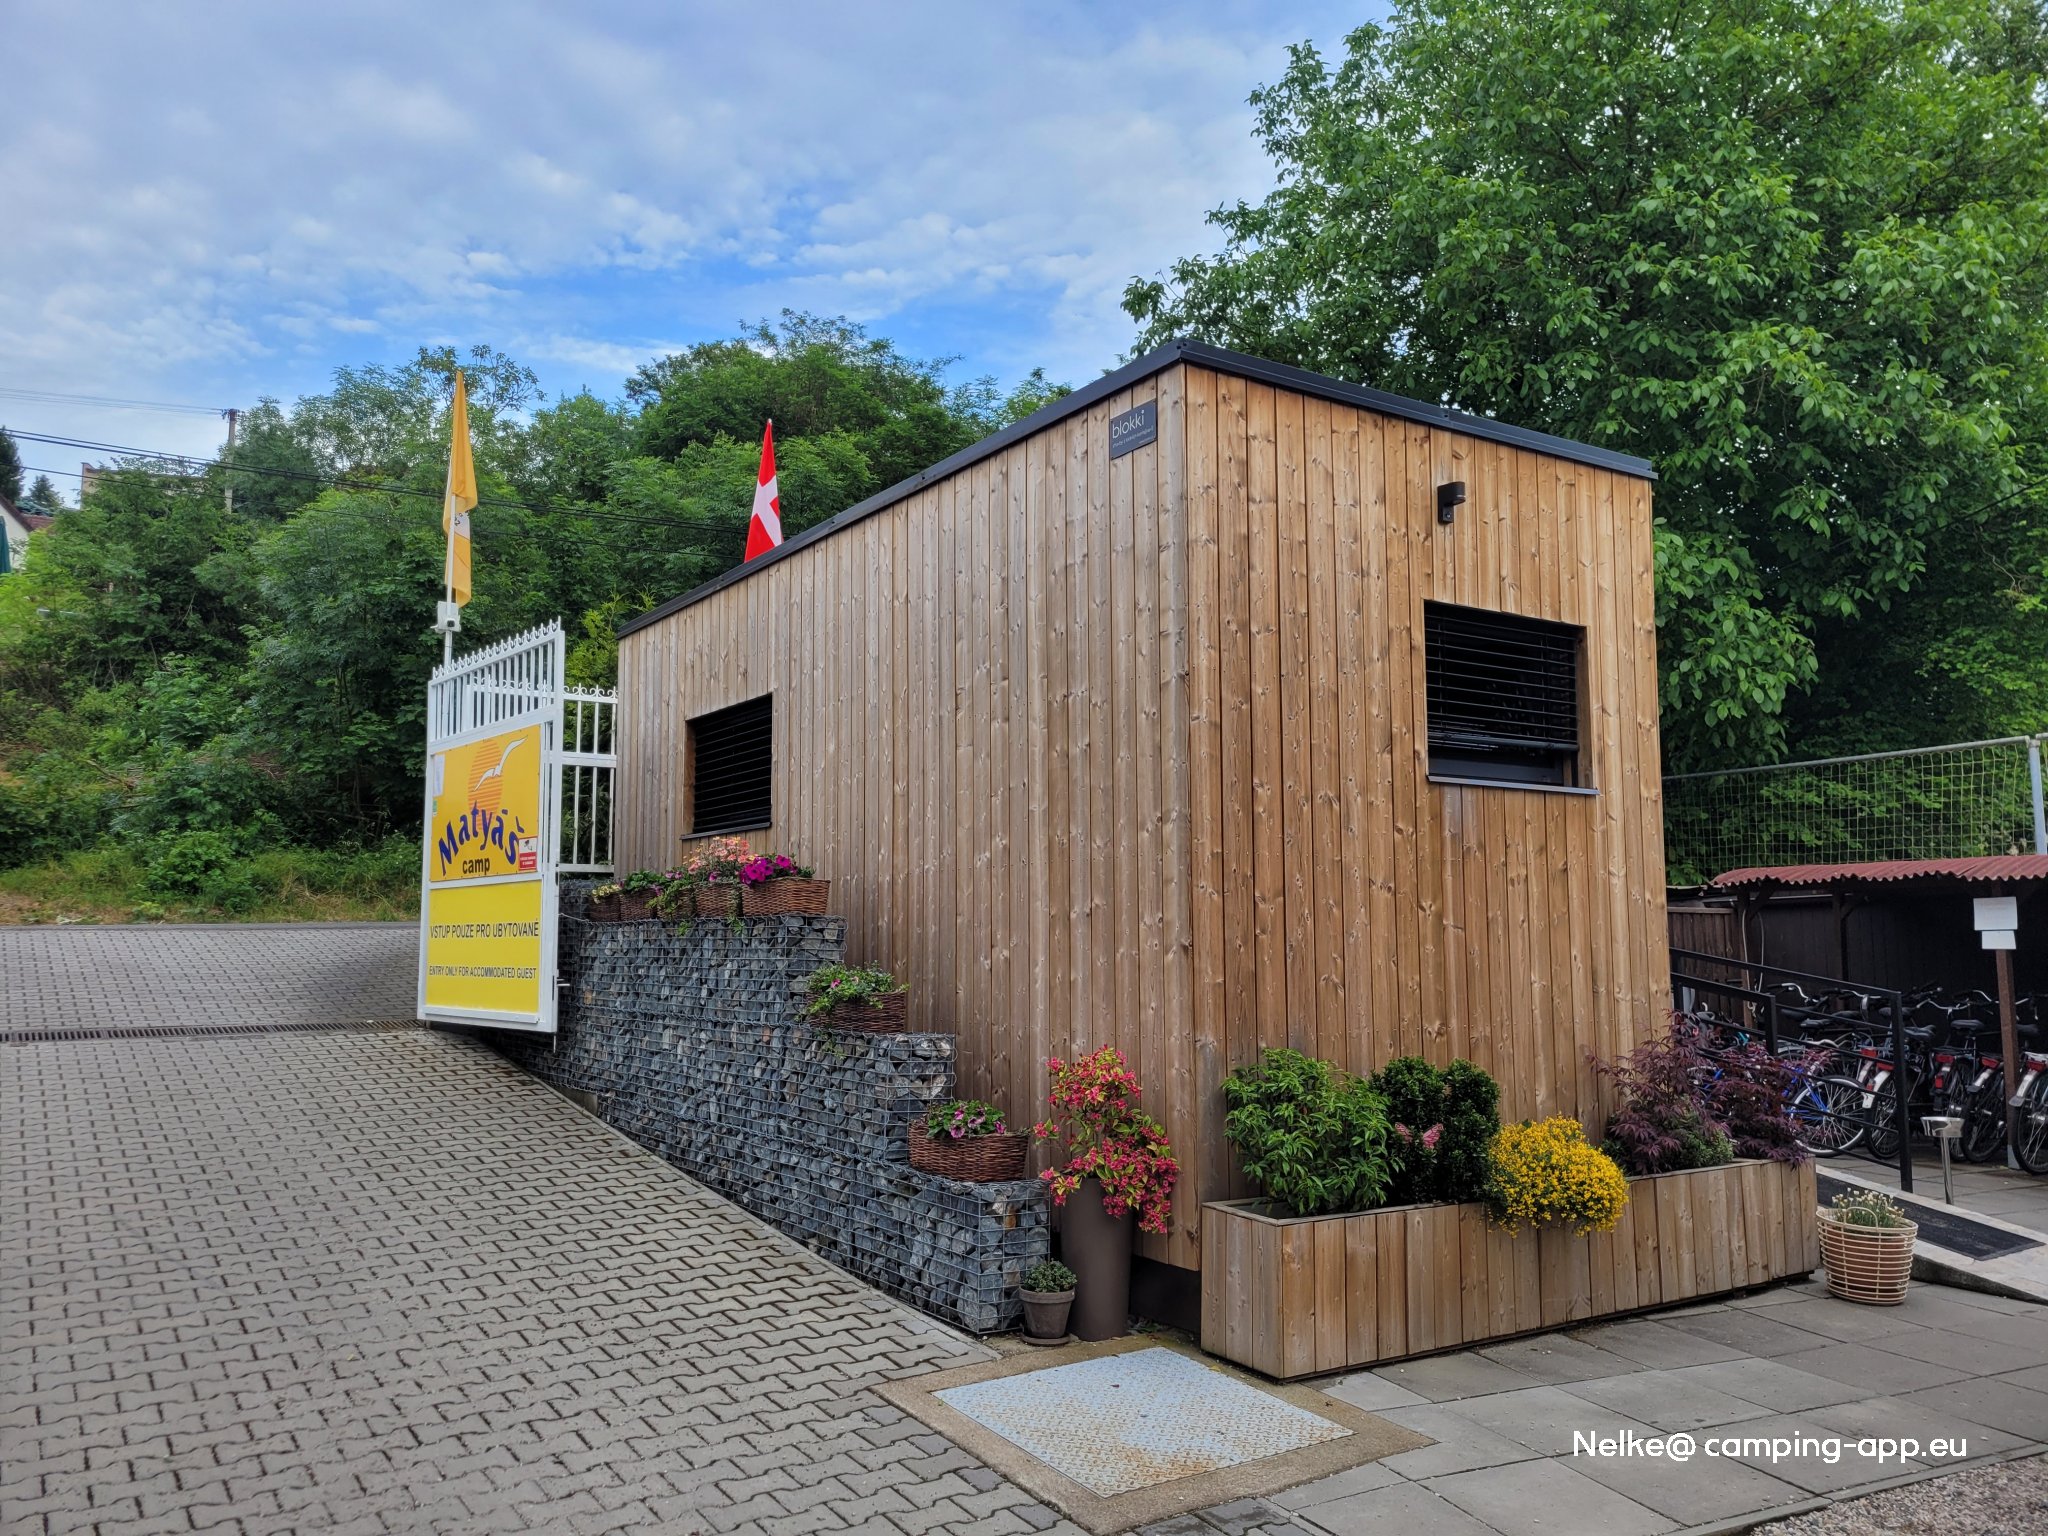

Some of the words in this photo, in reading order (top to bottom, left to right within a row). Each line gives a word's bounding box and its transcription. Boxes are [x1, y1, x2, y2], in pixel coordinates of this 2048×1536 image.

[1112, 410, 1145, 439] blokki
[462, 857, 490, 875] camp
[430, 924, 451, 939] VSTUP
[451, 923, 475, 939] POUZE
[475, 922, 491, 938] PRO
[492, 918, 539, 938] UBYTOVANÉ
[429, 965, 444, 976] ENTRY
[445, 966, 458, 976] ONLY
[458, 966, 470, 977] FOR
[470, 966, 515, 979] ACCOMMODATED
[516, 967, 537, 979] GUEST
